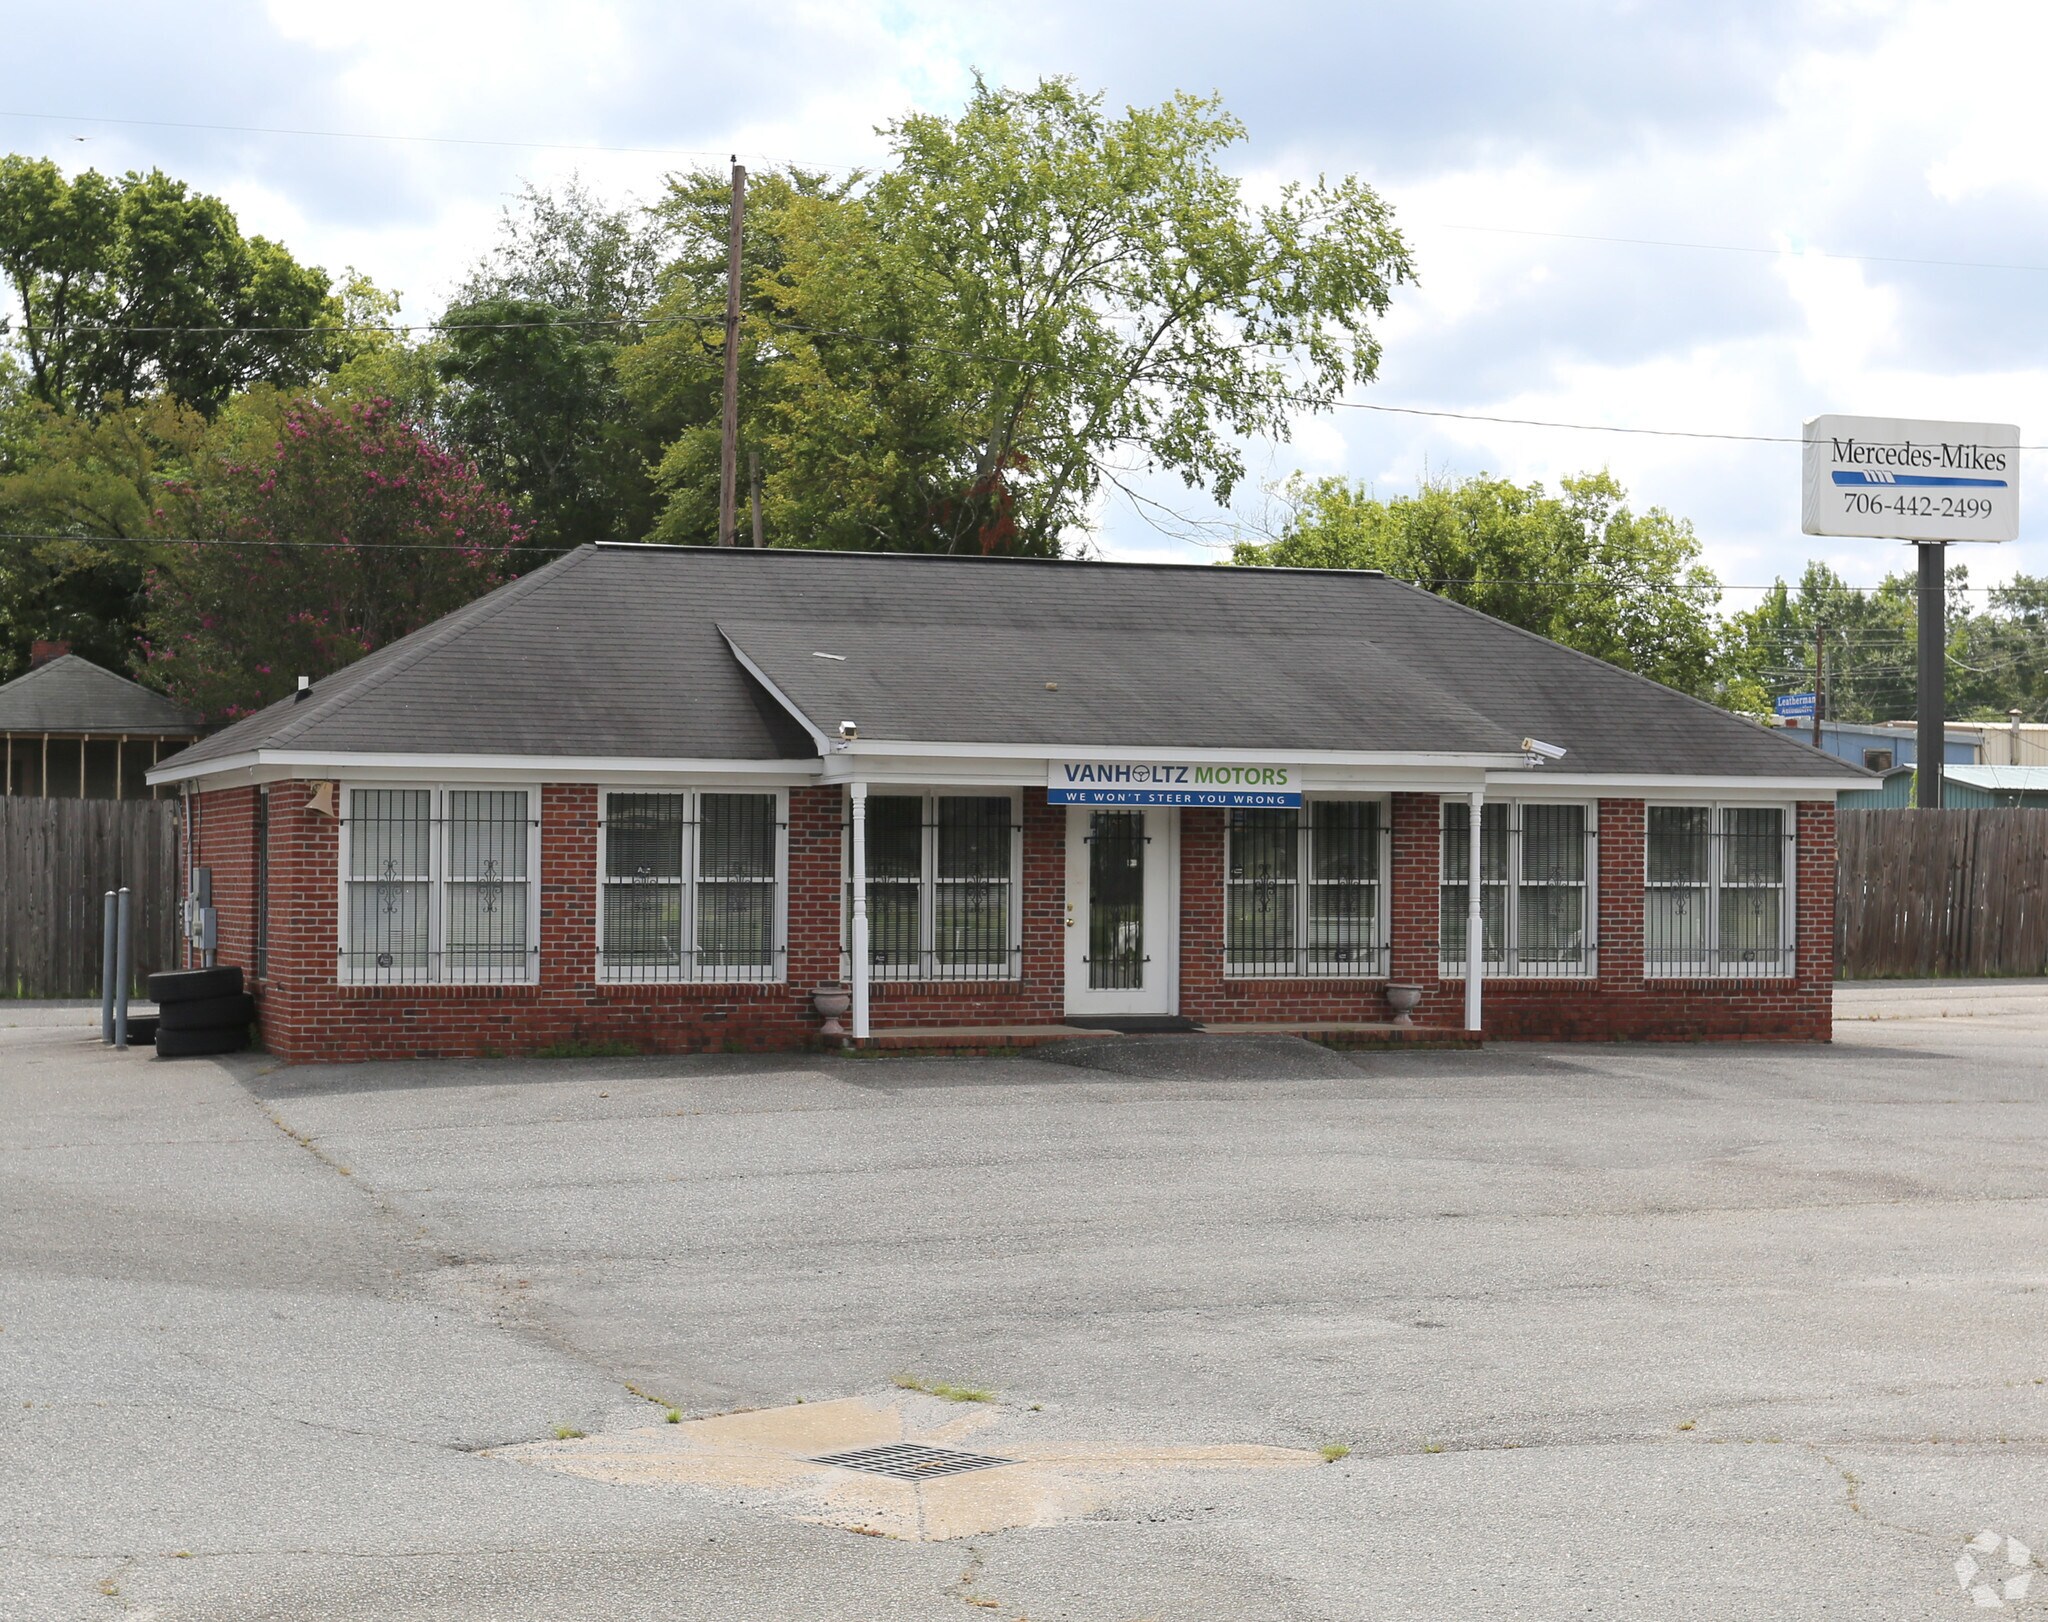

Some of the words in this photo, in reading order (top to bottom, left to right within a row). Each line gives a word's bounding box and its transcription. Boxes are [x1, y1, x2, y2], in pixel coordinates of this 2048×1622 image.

[1831, 437, 2006, 471] Mercedes-Mikes
[1844, 493, 1992, 519] 706-442-2499
[1777, 695, 1816, 707] Leatherman
[1064, 764, 1188, 784] VANHOLTZ
[1194, 766, 1288, 786] MOTORS
[1066, 792, 1086, 801] WE
[1094, 793, 1141, 802] WON'T
[1149, 794, 1192, 803] STEER
[1198, 795, 1226, 804] YOU
[1234, 796, 1285, 805] WRONG
